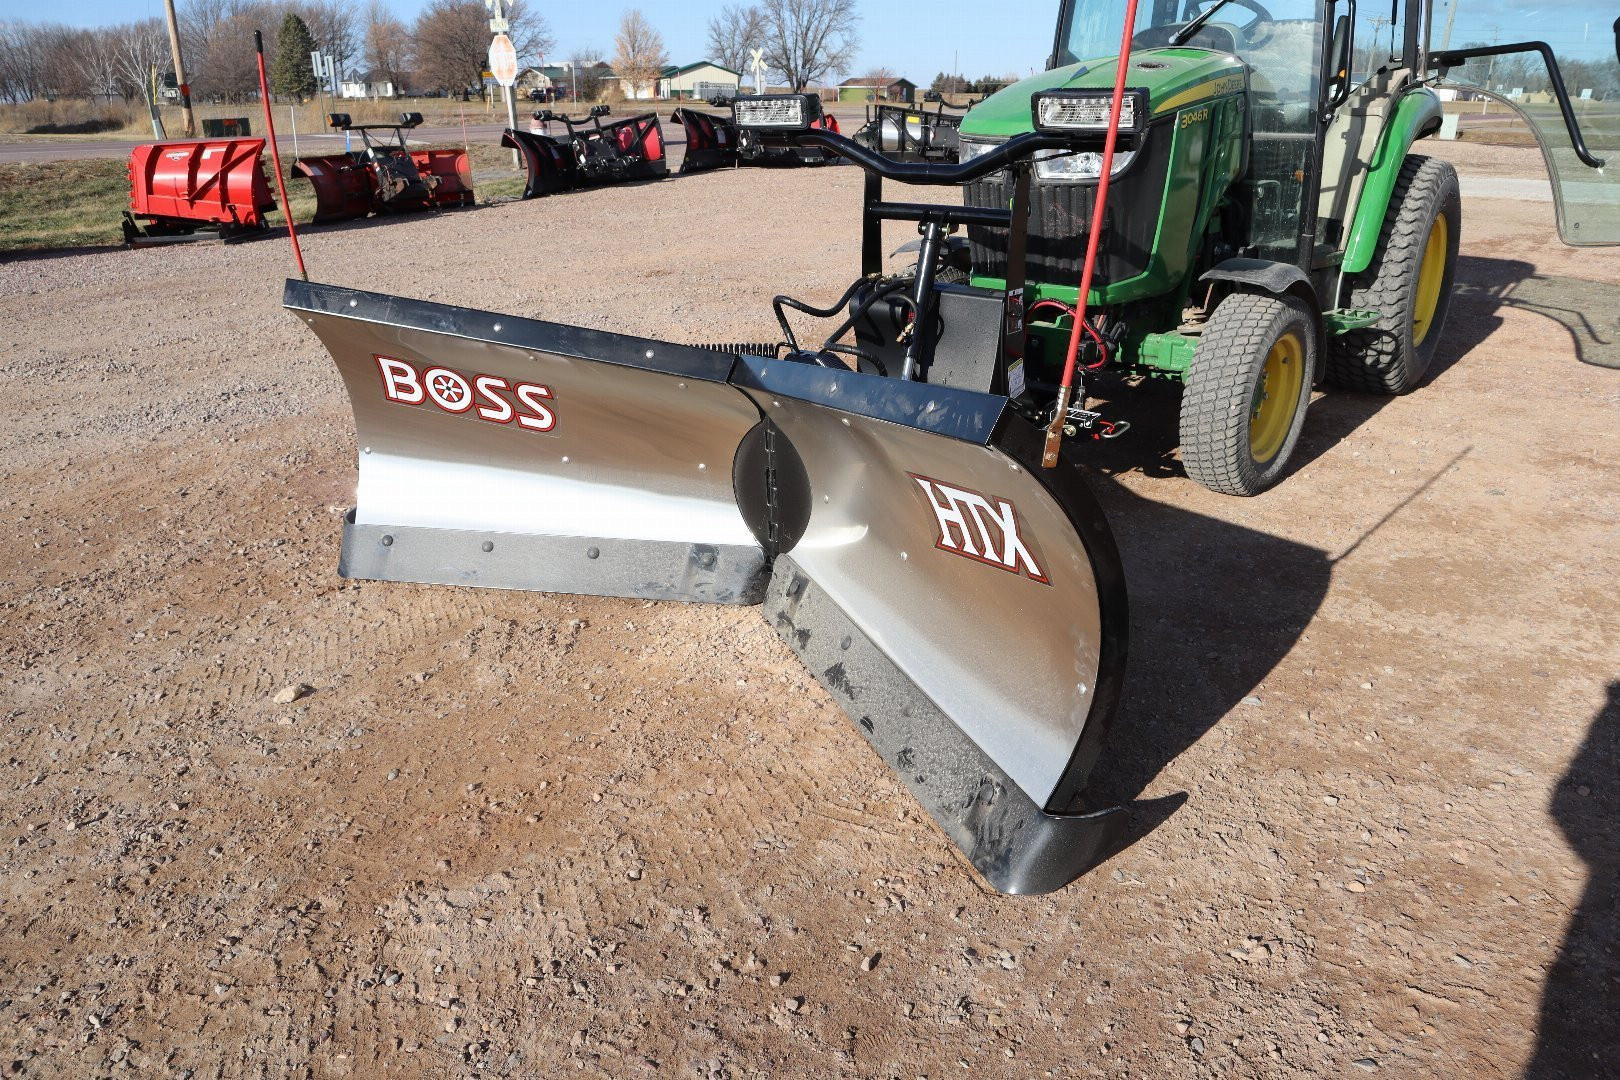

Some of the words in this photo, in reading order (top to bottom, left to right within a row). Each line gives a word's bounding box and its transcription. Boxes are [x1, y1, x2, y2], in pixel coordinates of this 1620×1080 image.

[1213, 81, 1228, 96] JOHN
[1228, 79, 1242, 92] DEERE
[1181, 109, 1208, 129] 3046R
[374, 354, 556, 431] BOSS
[909, 474, 1047, 583] HTX
